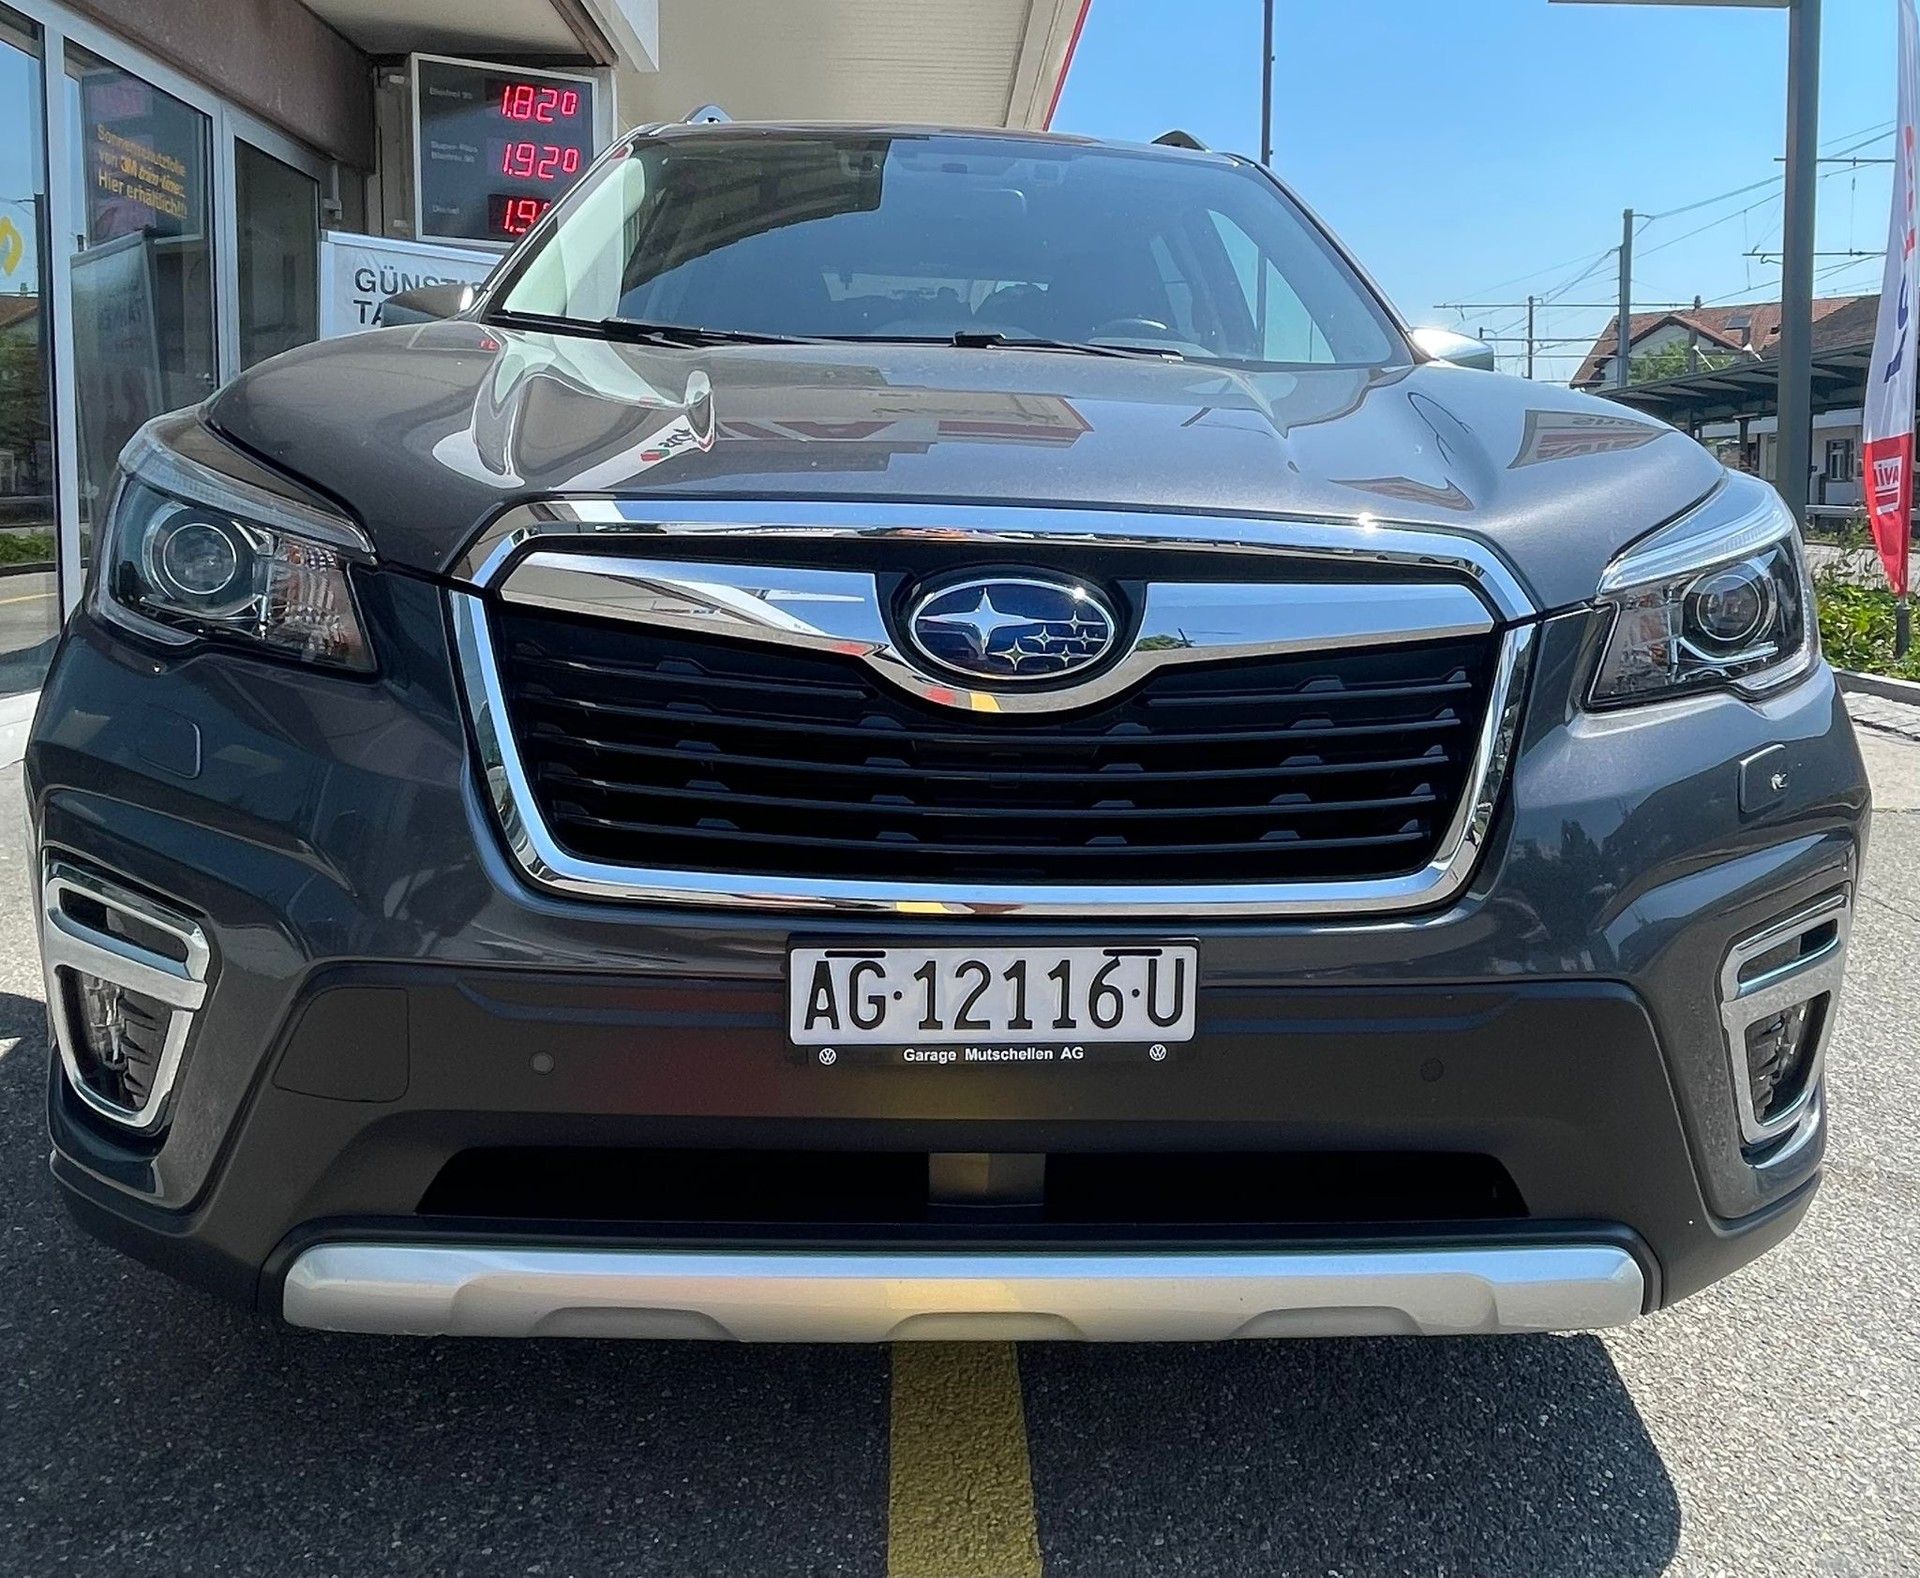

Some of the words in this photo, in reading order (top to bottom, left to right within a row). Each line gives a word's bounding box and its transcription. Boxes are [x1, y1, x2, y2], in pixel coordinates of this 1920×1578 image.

[98, 169, 124, 194] Hier
[903, 1048, 957, 1064] Garage
[965, 1047, 1053, 1062] Mutschellen
[1060, 1046, 1084, 1060] AG
